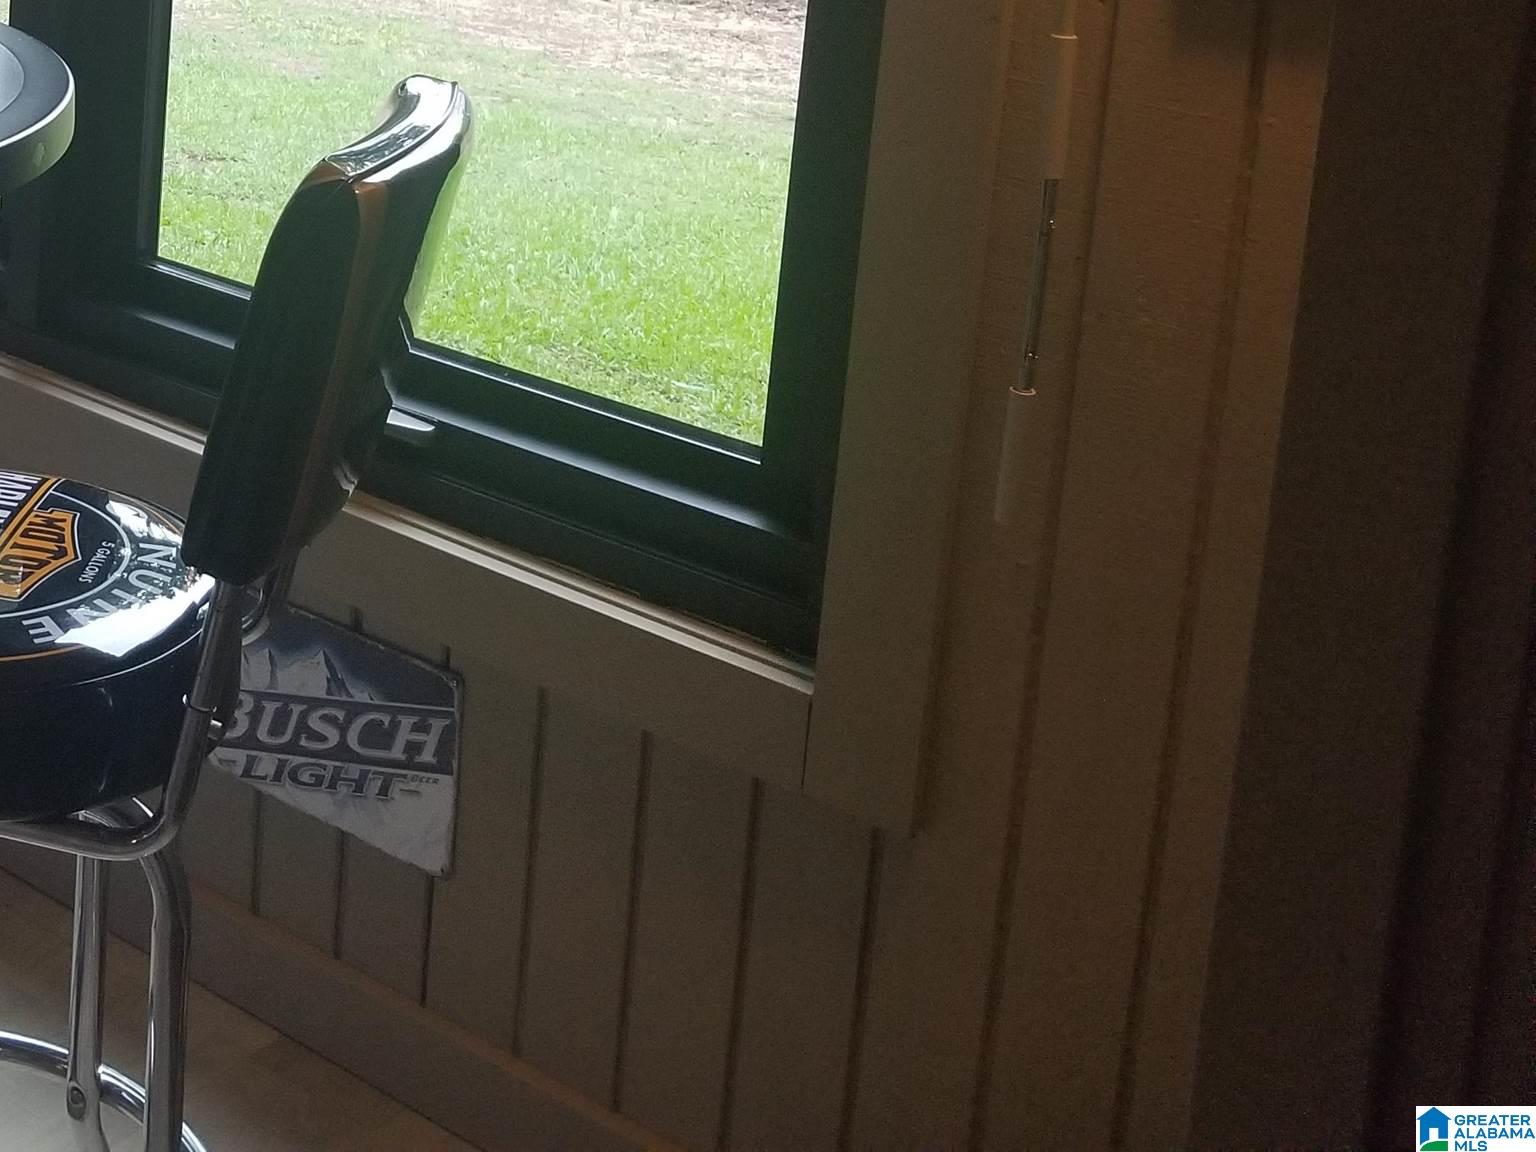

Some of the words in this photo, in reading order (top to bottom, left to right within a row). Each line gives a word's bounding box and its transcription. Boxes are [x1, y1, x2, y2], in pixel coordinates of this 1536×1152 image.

[101, 540, 115, 549] 5
[78, 548, 112, 584] GALLONS
[22, 540, 178, 645] NUINE
[240, 753, 408, 799] LIGHT
